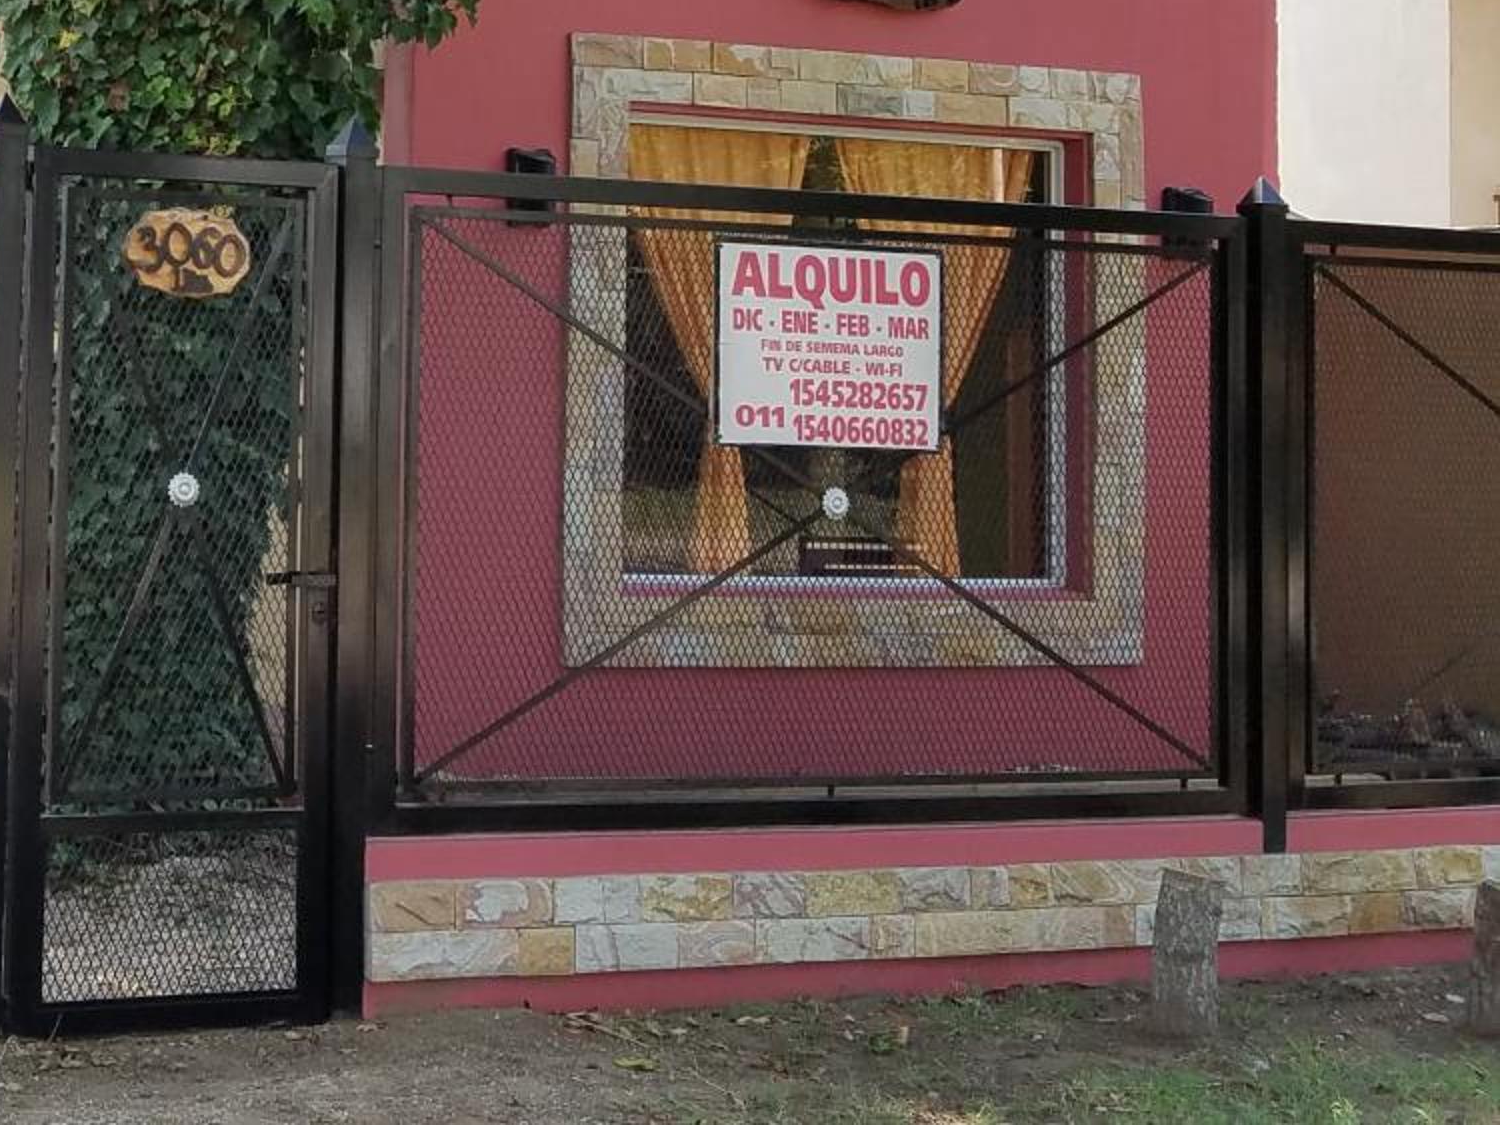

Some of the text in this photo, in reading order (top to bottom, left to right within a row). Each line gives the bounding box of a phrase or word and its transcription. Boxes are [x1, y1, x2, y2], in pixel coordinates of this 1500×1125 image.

[127, 222, 247, 279] 3060
[731, 250, 931, 310] ALQUILO
[733, 308, 763, 331] DIC
[781, 310, 818, 334] ENE
[836, 313, 870, 337] FEB
[888, 316, 929, 340] MAR
[761, 339, 781, 352] FIN
[786, 340, 802, 352] DE
[864, 345, 903, 357] LARGO
[763, 357, 783, 372] TV
[789, 358, 850, 374] C/CABLE
[866, 362, 902, 377] WI-FI
[789, 379, 928, 411] 1545282657
[735, 405, 928, 446] 011 1540660832
